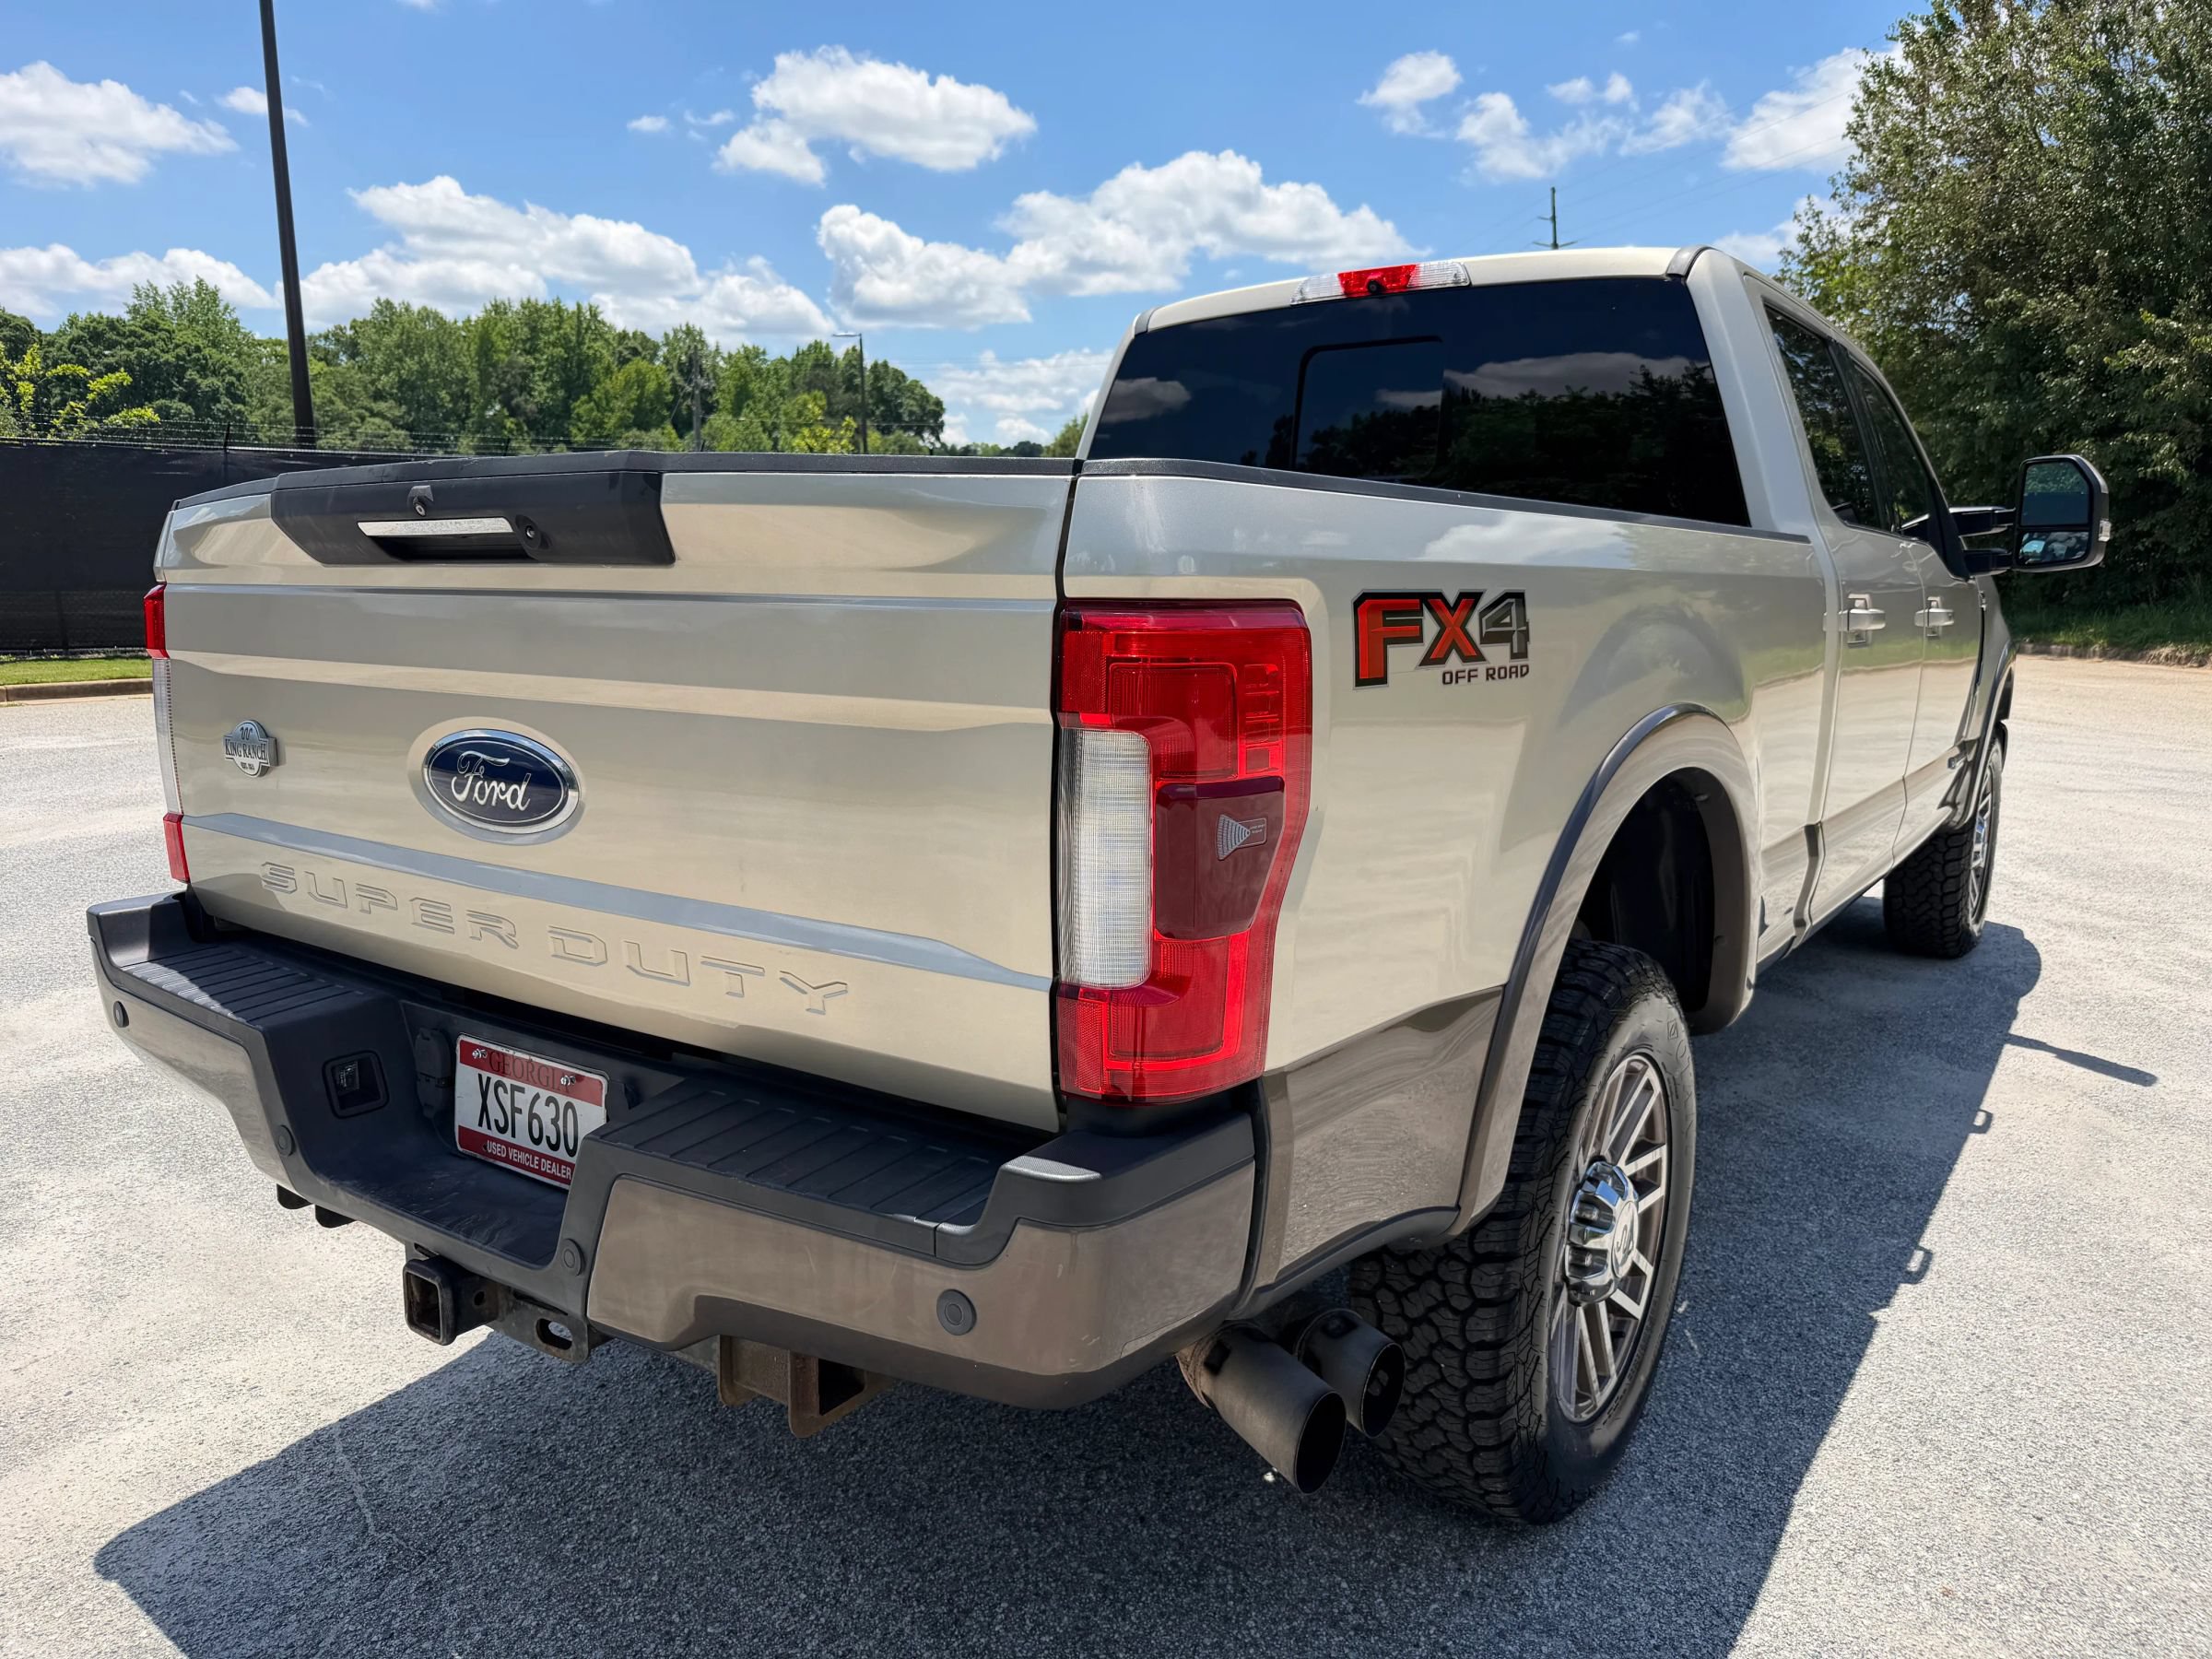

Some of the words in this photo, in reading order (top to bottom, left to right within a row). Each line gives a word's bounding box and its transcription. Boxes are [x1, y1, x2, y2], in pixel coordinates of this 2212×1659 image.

[1351, 590, 1530, 688] FX4
[1441, 667, 1478, 686] OFF
[1485, 664, 1530, 682] ROAD
[225, 738, 242, 758] KING
[451, 750, 532, 811] Ford
[261, 861, 520, 950] SUPER
[547, 924, 849, 1016] DUTY
[477, 1073, 579, 1158] XSF630
[487, 1140, 507, 1158] USED
[508, 1149, 539, 1170] VEHICLE
[541, 1159, 572, 1181] DEALER
